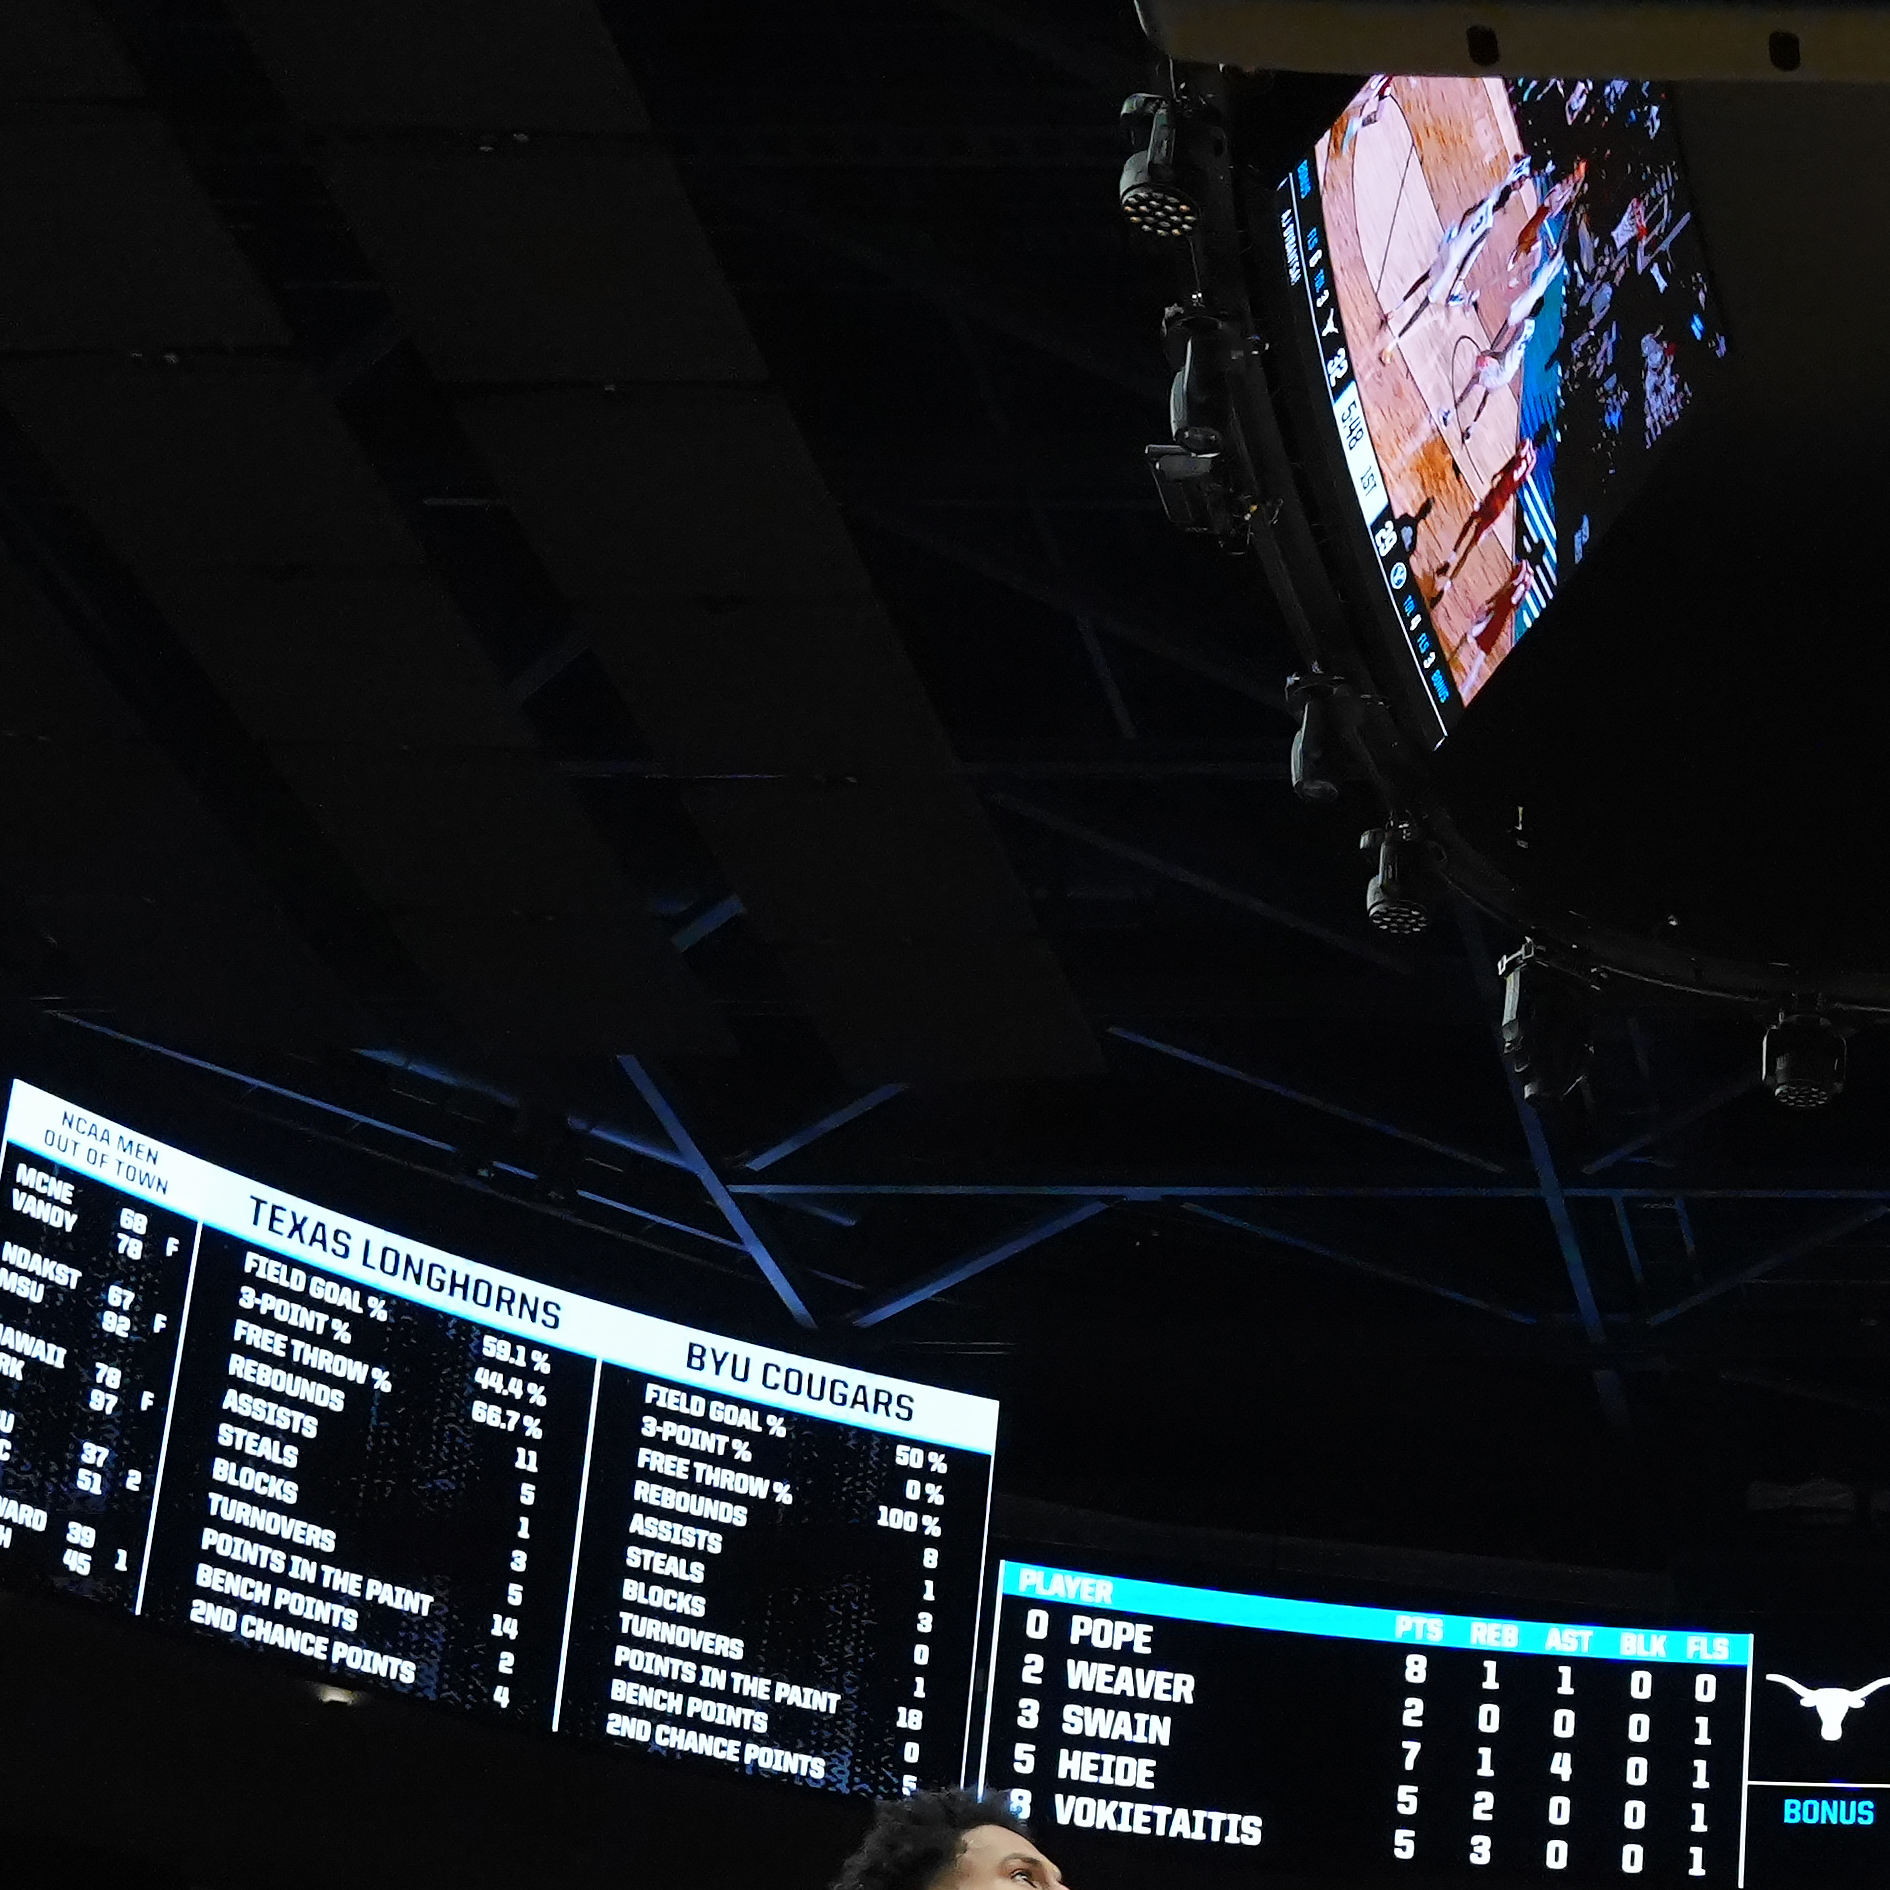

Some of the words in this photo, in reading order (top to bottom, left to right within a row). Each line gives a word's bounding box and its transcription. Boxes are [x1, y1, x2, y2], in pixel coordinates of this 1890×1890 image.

[62, 1111, 109, 1145] NCAA
[117, 1135, 158, 1165] MEN
[16, 1163, 74, 1204] MCNE
[44, 1129, 79, 1156] OUT
[86, 1148, 107, 1168] OF
[116, 1159, 168, 1195] TOWN
[12, 1188, 77, 1232] VANDY
[1, 1241, 82, 1289] NDAKST
[244, 1251, 306, 1291] FIELD
[309, 1276, 363, 1313] GOAL
[251, 1195, 351, 1259] TEXAS
[362, 1239, 560, 1329] LONGHORNS
[238, 1285, 329, 1334] 3-POINT
[233, 1319, 288, 1357] FREE
[290, 1339, 369, 1384] THROW
[482, 1334, 526, 1367] 59.1
[228, 1353, 345, 1411] REBOUNDS
[474, 1367, 523, 1399] 44.4
[686, 1342, 750, 1382] BYU
[762, 1362, 913, 1421] COUGARS
[222, 1389, 318, 1438] ASSISTS
[471, 1400, 520, 1431] 66.7
[645, 1382, 705, 1417] FIELD
[709, 1400, 762, 1432] GOAL
[217, 1423, 298, 1468] STEALS
[641, 1415, 729, 1455] 3-POINT
[895, 1444, 923, 1468] 50
[212, 1457, 298, 1504] BLOCKS
[637, 1447, 690, 1479] FREE
[693, 1461, 770, 1499] THROW
[208, 1492, 336, 1552] TURNOVERS
[633, 1480, 747, 1526] REBOUNDS
[877, 1505, 918, 1532] 100
[629, 1513, 722, 1553] ASSISTS
[201, 1527, 286, 1573] POINTS
[288, 1555, 317, 1583] IN
[321, 1564, 363, 1597] THE
[365, 1578, 434, 1616] PAINT
[626, 1545, 704, 1583] STEALS
[1019, 1568, 1112, 1603] PLAYER
[195, 1563, 271, 1605] BENCH
[274, 1587, 358, 1631] POINTS
[622, 1578, 706, 1617] BLOCKS
[189, 1599, 237, 1632] 2ND
[240, 1614, 329, 1660] CHANCE
[331, 1641, 416, 1683] POINTS
[490, 1613, 518, 1639] 14
[619, 1611, 744, 1660] TURNOVERS
[1026, 1609, 1048, 1639] 0
[1070, 1615, 1153, 1654] POPE
[1396, 1615, 1443, 1641] PTS
[1471, 1622, 1518, 1647] REB
[1545, 1628, 1593, 1652] AST
[1620, 1632, 1666, 1657] BLK
[1687, 1636, 1728, 1659] FLS
[1021, 1653, 1043, 1684] 2
[1067, 1659, 1194, 1704] WEAVER
[1017, 1698, 1039, 1728] 3
[1061, 1704, 1171, 1746] SWAIN
[1013, 1742, 1035, 1774] 5
[1057, 1748, 1156, 1789] HEIDE
[1054, 1793, 1262, 1845] VOKIETAITIS
[1783, 1798, 1874, 1825] BONUS
